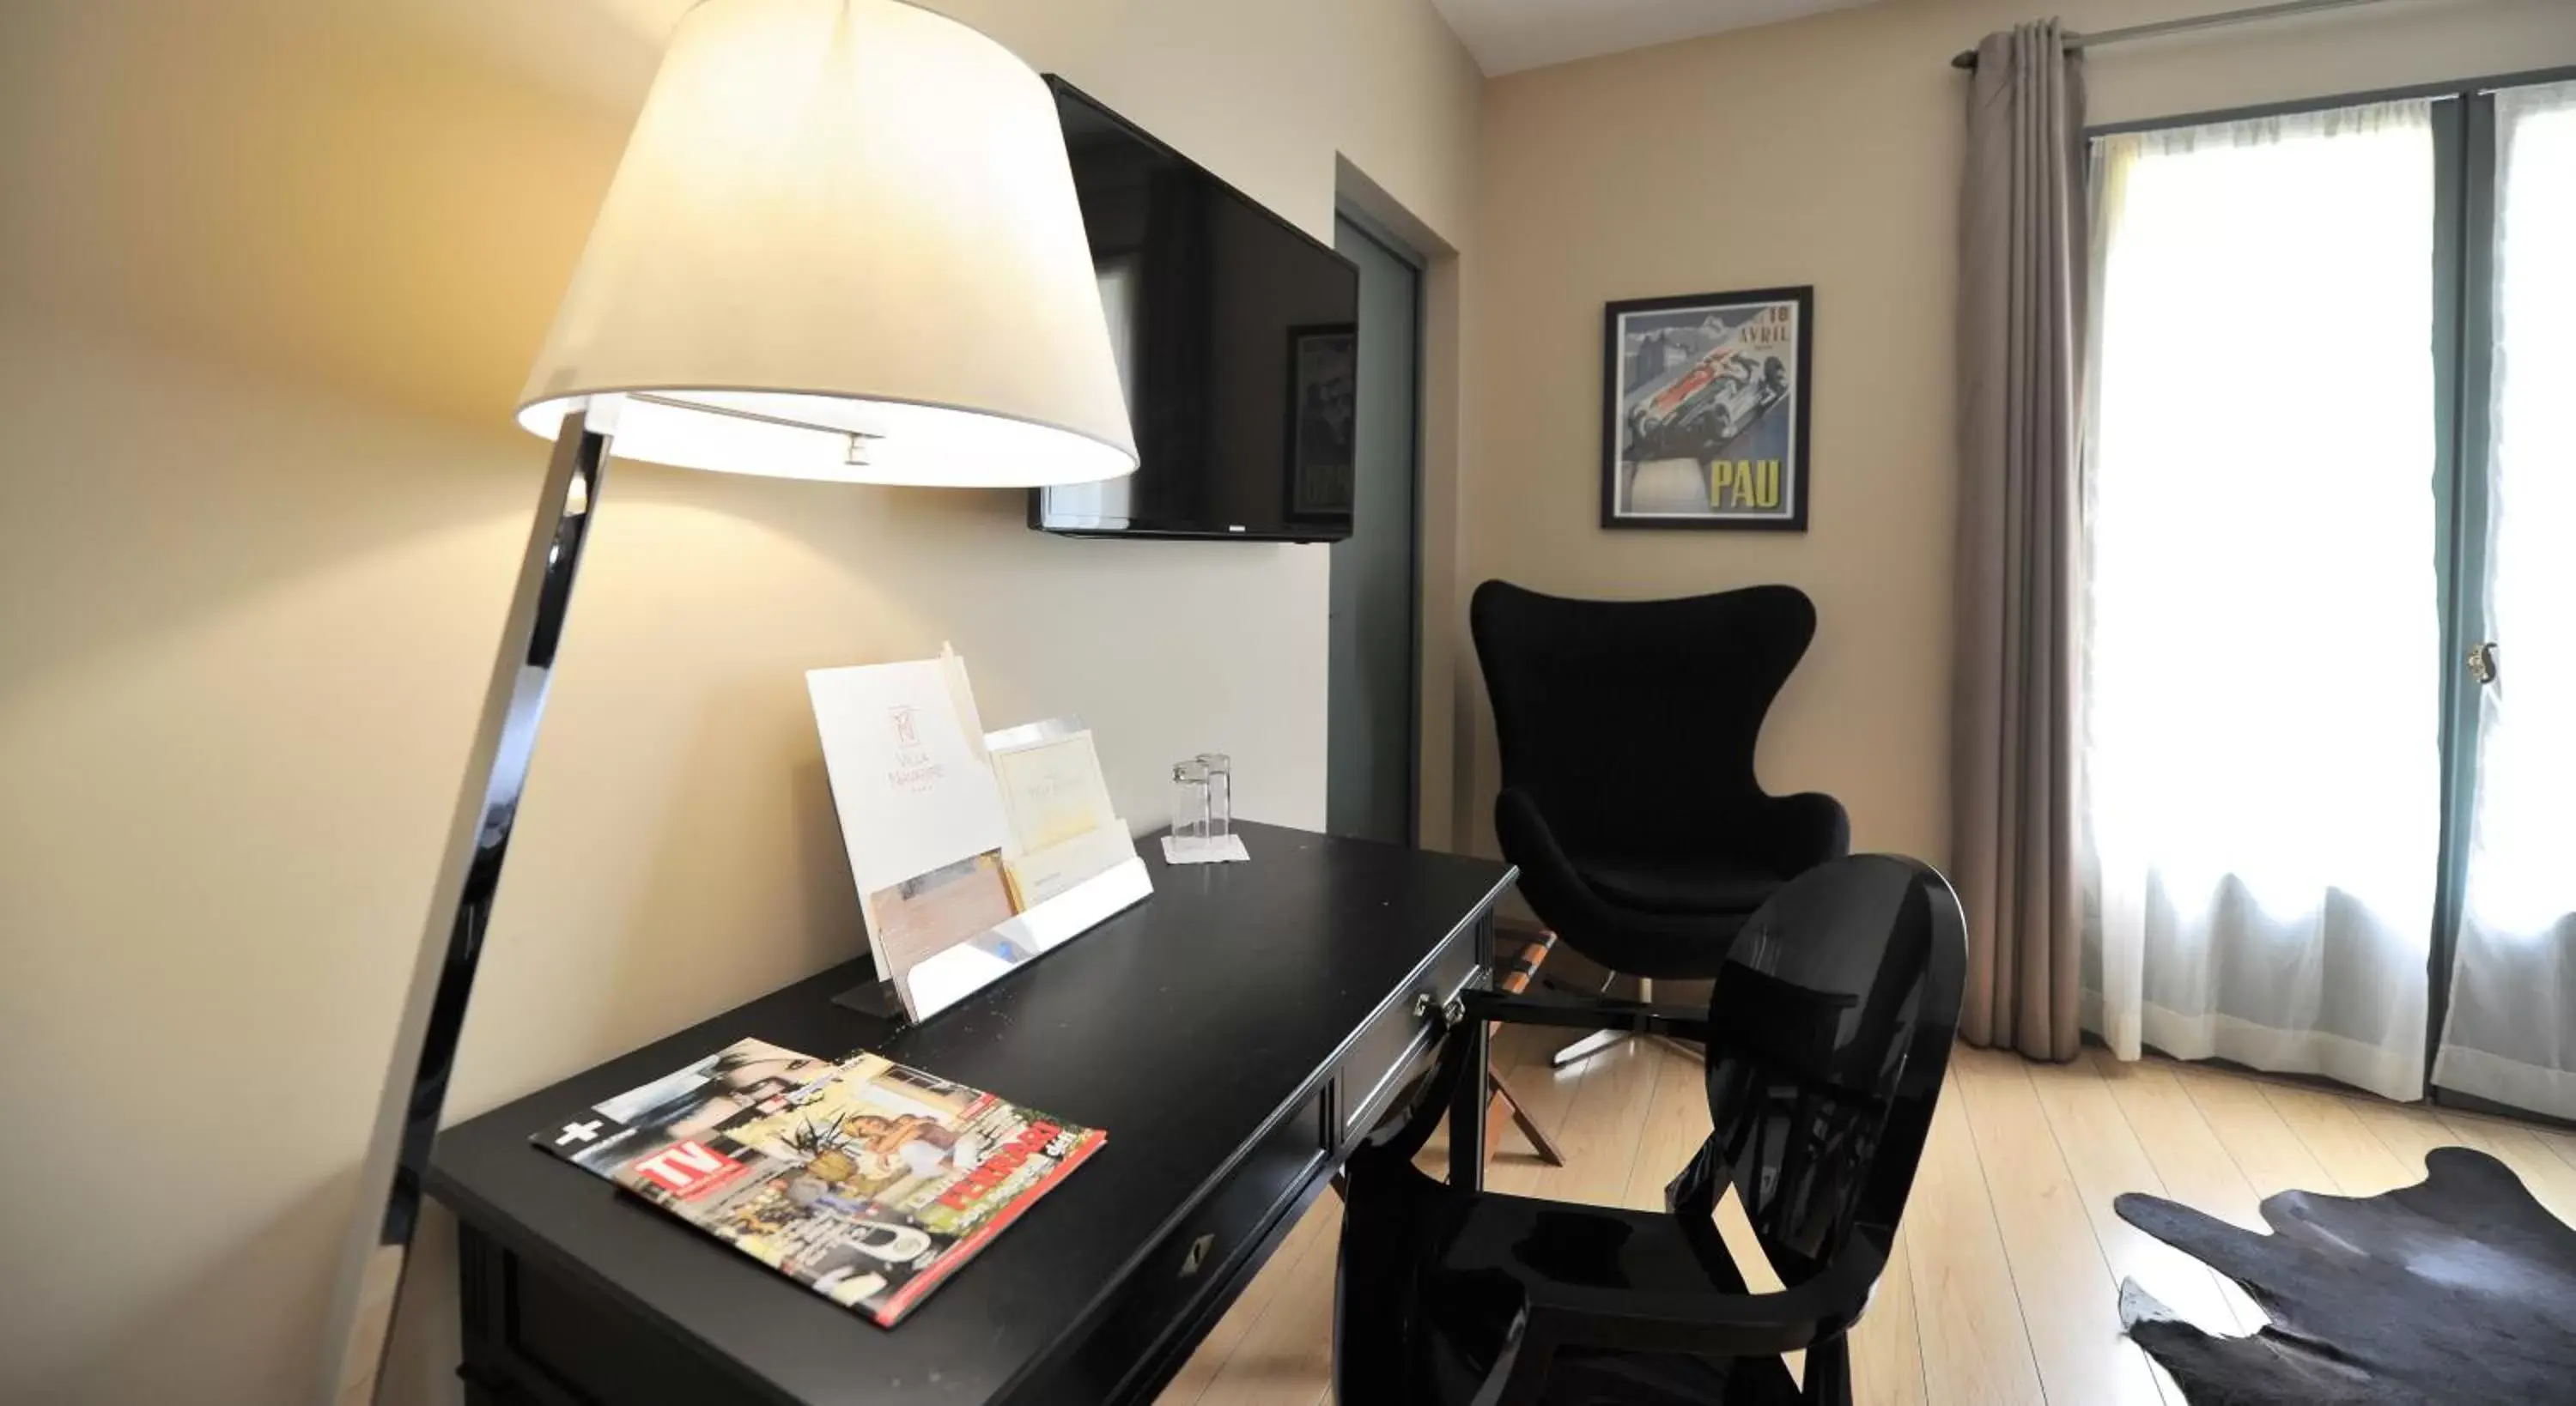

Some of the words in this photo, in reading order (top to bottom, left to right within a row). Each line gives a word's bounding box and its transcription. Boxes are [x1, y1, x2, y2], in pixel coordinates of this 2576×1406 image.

[1739, 325, 1790, 344] AVRIL
[1710, 459, 1780, 508] PAU
[635, 1140, 723, 1187] TV
[939, 1119, 1061, 1211] FERRARI
